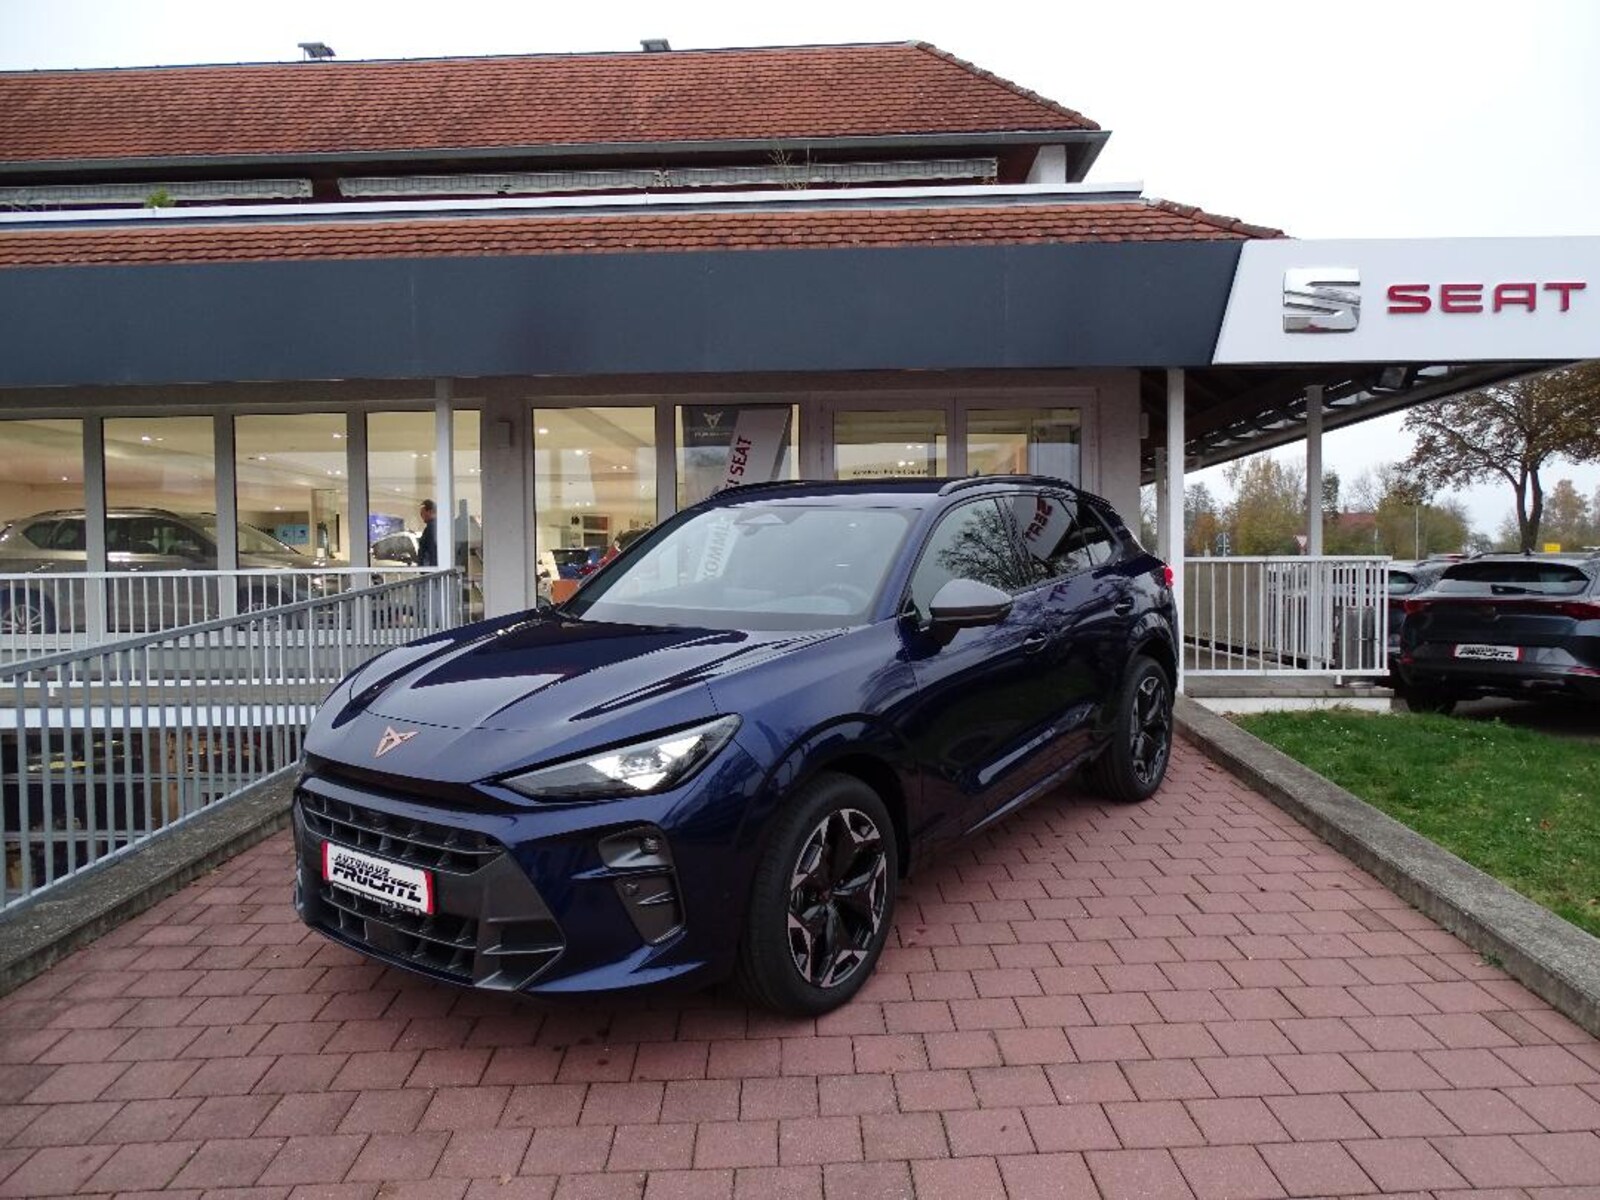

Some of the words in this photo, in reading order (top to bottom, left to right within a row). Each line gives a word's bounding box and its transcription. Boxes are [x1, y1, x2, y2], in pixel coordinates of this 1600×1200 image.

[1386, 282, 1587, 314] SEAT
[729, 436, 752, 476] SEAT
[335, 853, 390, 876] AUTOHAUS
